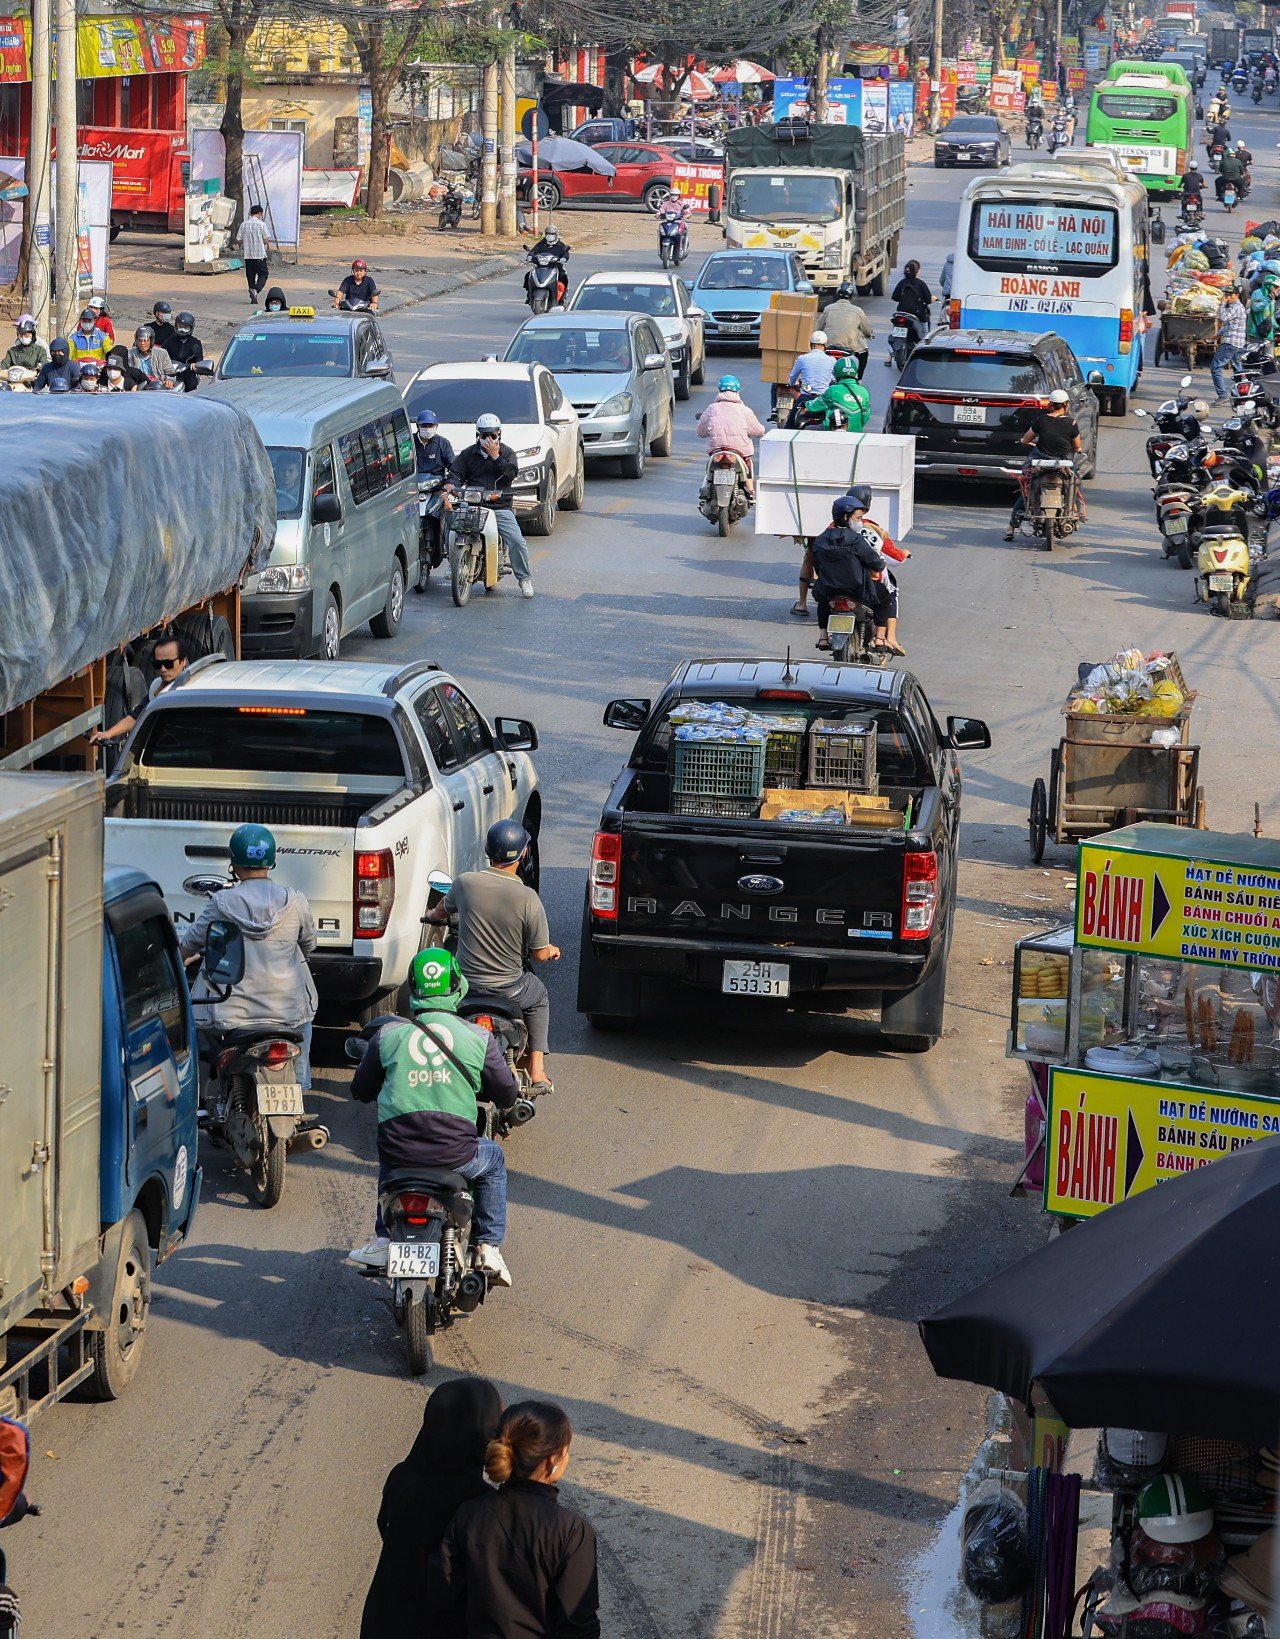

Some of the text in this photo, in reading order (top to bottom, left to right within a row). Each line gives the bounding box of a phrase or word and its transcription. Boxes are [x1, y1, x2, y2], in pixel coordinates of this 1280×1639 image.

[994, 94, 1010, 107] CÁ
[988, 208, 1011, 229] HẢI
[1015, 211, 1044, 233] HẬU
[1057, 213, 1077, 233] HÀ
[1081, 216, 1106, 237] NỘI
[982, 236, 1003, 250] NAM
[1005, 237, 1027, 252] ĐỊNH
[1065, 240, 1082, 256] LẠC
[1026, 264, 1058, 273] SAMCO
[1000, 273, 1081, 298] HOÀNG ANH
[1008, 298, 1028, 312] 18B
[1037, 299, 1073, 314] 021.68
[276, 846, 343, 858] WILDTRAK
[1185, 867, 1213, 884] HẠT
[1215, 868, 1234, 885] DẺ
[1083, 859, 1144, 944] BÁNH
[1184, 885, 1223, 903] BÁNH
[1226, 889, 1255, 908] SẦU
[627, 895, 893, 929] RANGER
[1183, 904, 1221, 922] BÁNH
[1225, 906, 1268, 928] CHUỐI
[1182, 923, 1208, 939] XÚC
[1211, 926, 1241, 944] XÍCH
[1181, 942, 1216, 959] BÁNH
[1219, 944, 1239, 962] MỲ
[742, 963, 771, 979] 29H
[424, 981, 442, 989] gojek
[730, 977, 781, 996] 533.31
[408, 1068, 453, 1087] gojek
[264, 1086, 296, 1099] 18-T1
[265, 1099, 297, 1113] 1787
[1159, 1098, 1186, 1121] HẠT
[1189, 1100, 1207, 1122] DẺ
[1209, 1106, 1258, 1131] NƯỚNG
[1157, 1124, 1228, 1151] BÁNH SẦU
[1056, 1091, 1118, 1205] BÁNH
[1156, 1151, 1195, 1172] BÁNH
[397, 1245, 432, 1260] 18-B2
[390, 1260, 436, 1275] 244.28
